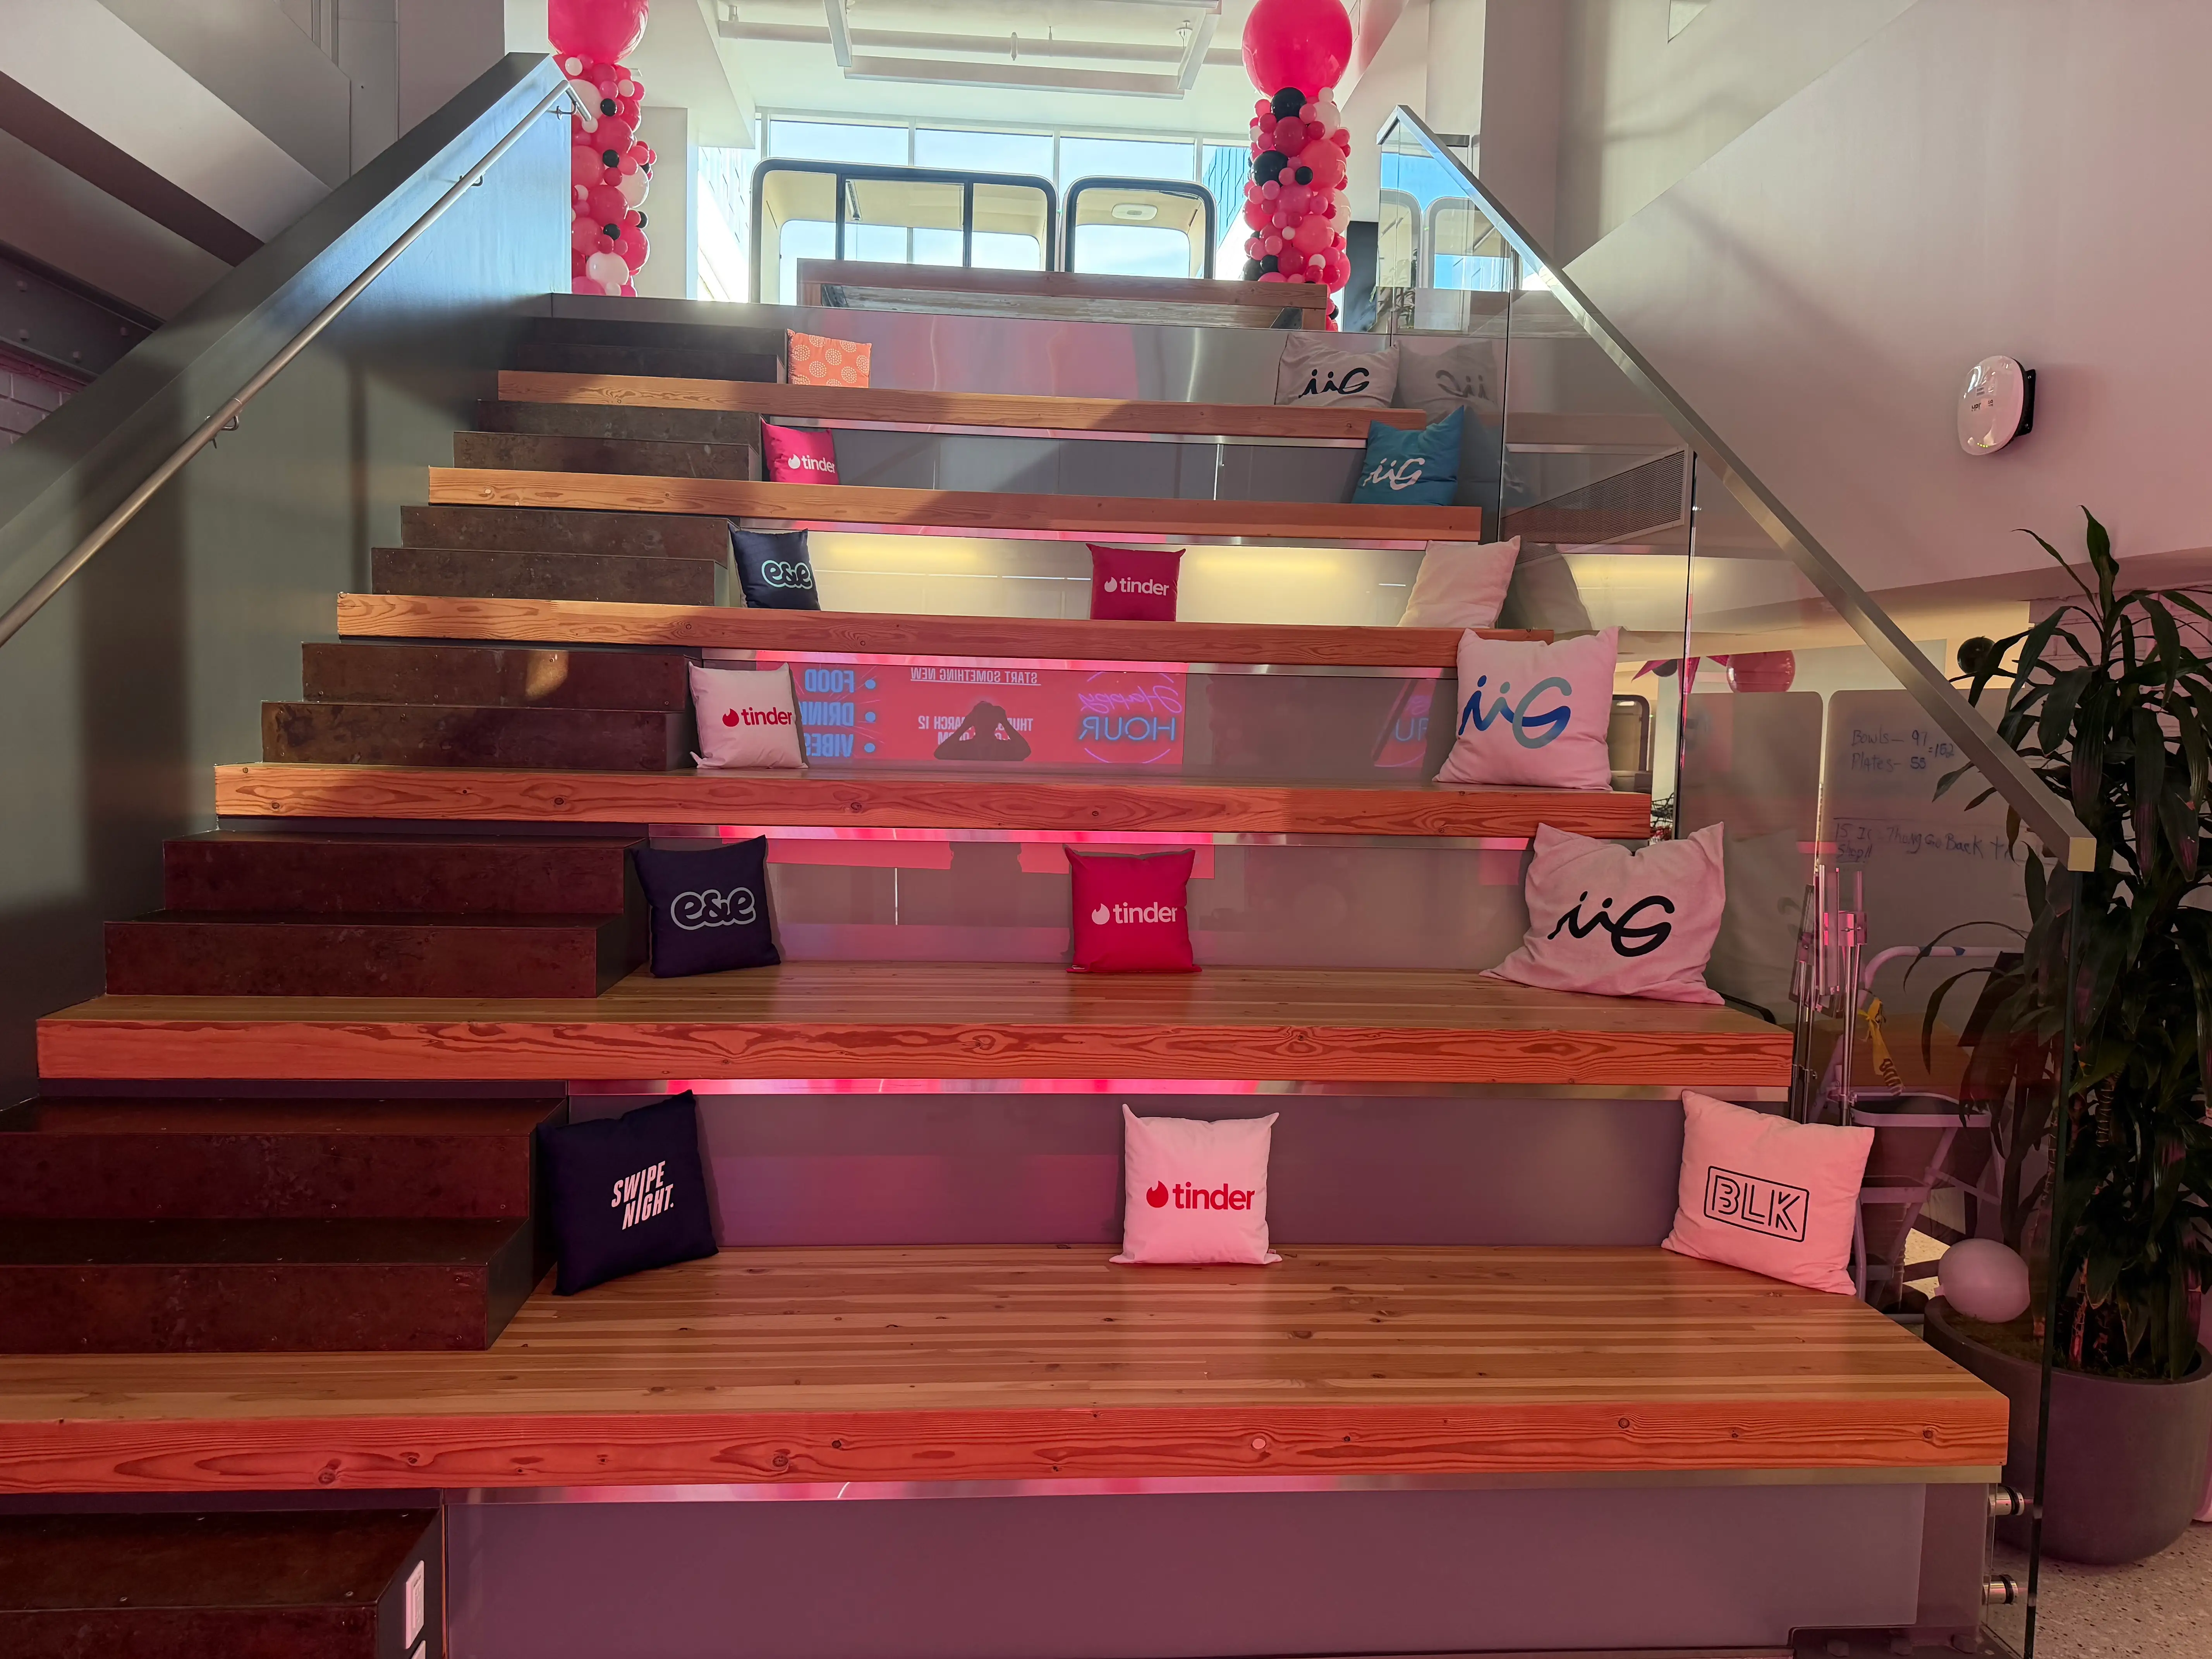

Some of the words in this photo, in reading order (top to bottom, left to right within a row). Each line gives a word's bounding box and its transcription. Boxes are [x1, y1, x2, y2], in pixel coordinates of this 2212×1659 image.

[801, 455, 835, 473] tinder
[1120, 577, 1169, 596] tinder
[741, 707, 792, 725] tinder
[1911, 729, 1928, 746] 97
[1113, 902, 1178, 924] tinder
[611, 1161, 665, 1208] SWIPE
[1173, 1182, 1255, 1210] tinder
[1712, 1175, 1800, 1233] BLK
